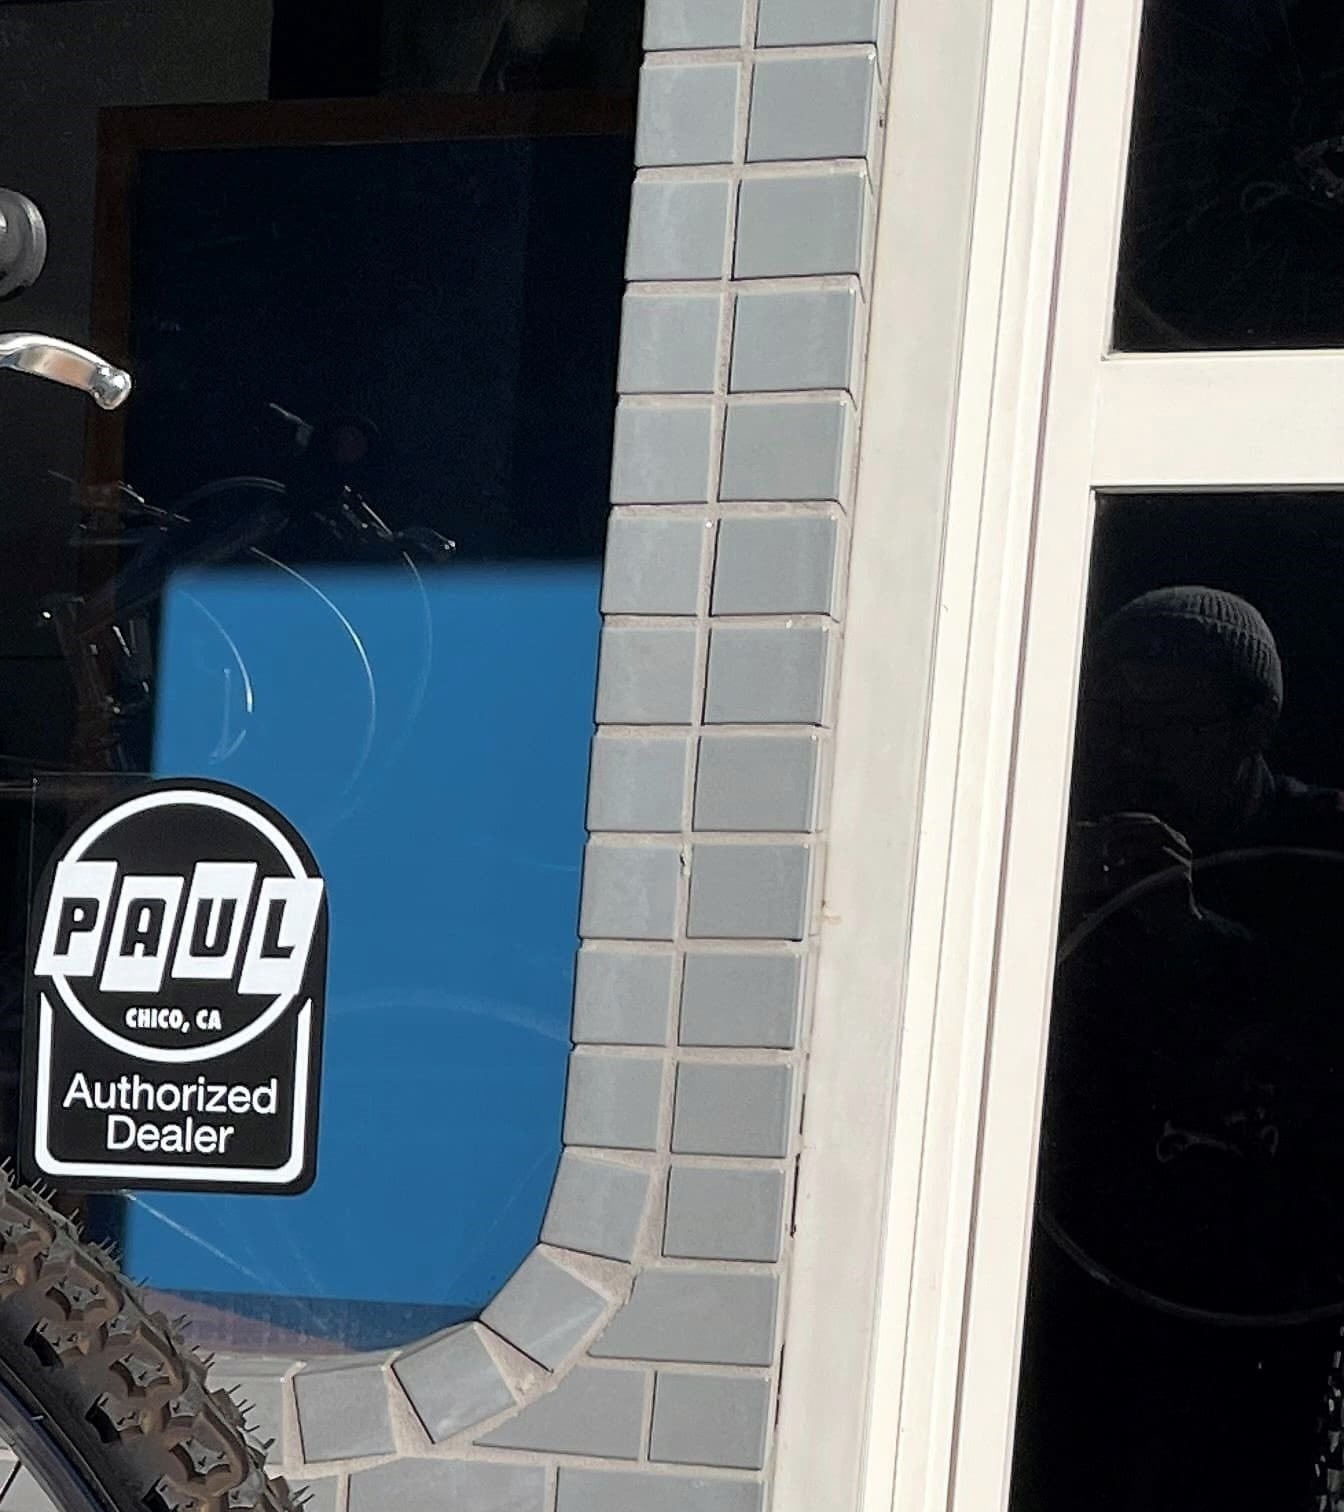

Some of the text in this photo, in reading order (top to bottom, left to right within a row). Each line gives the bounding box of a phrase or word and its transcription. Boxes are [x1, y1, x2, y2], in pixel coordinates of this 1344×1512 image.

[125, 1007, 222, 1034] CHICO, CA
[63, 1072, 279, 1115] Authorized
[106, 1115, 235, 1154] Dealer
